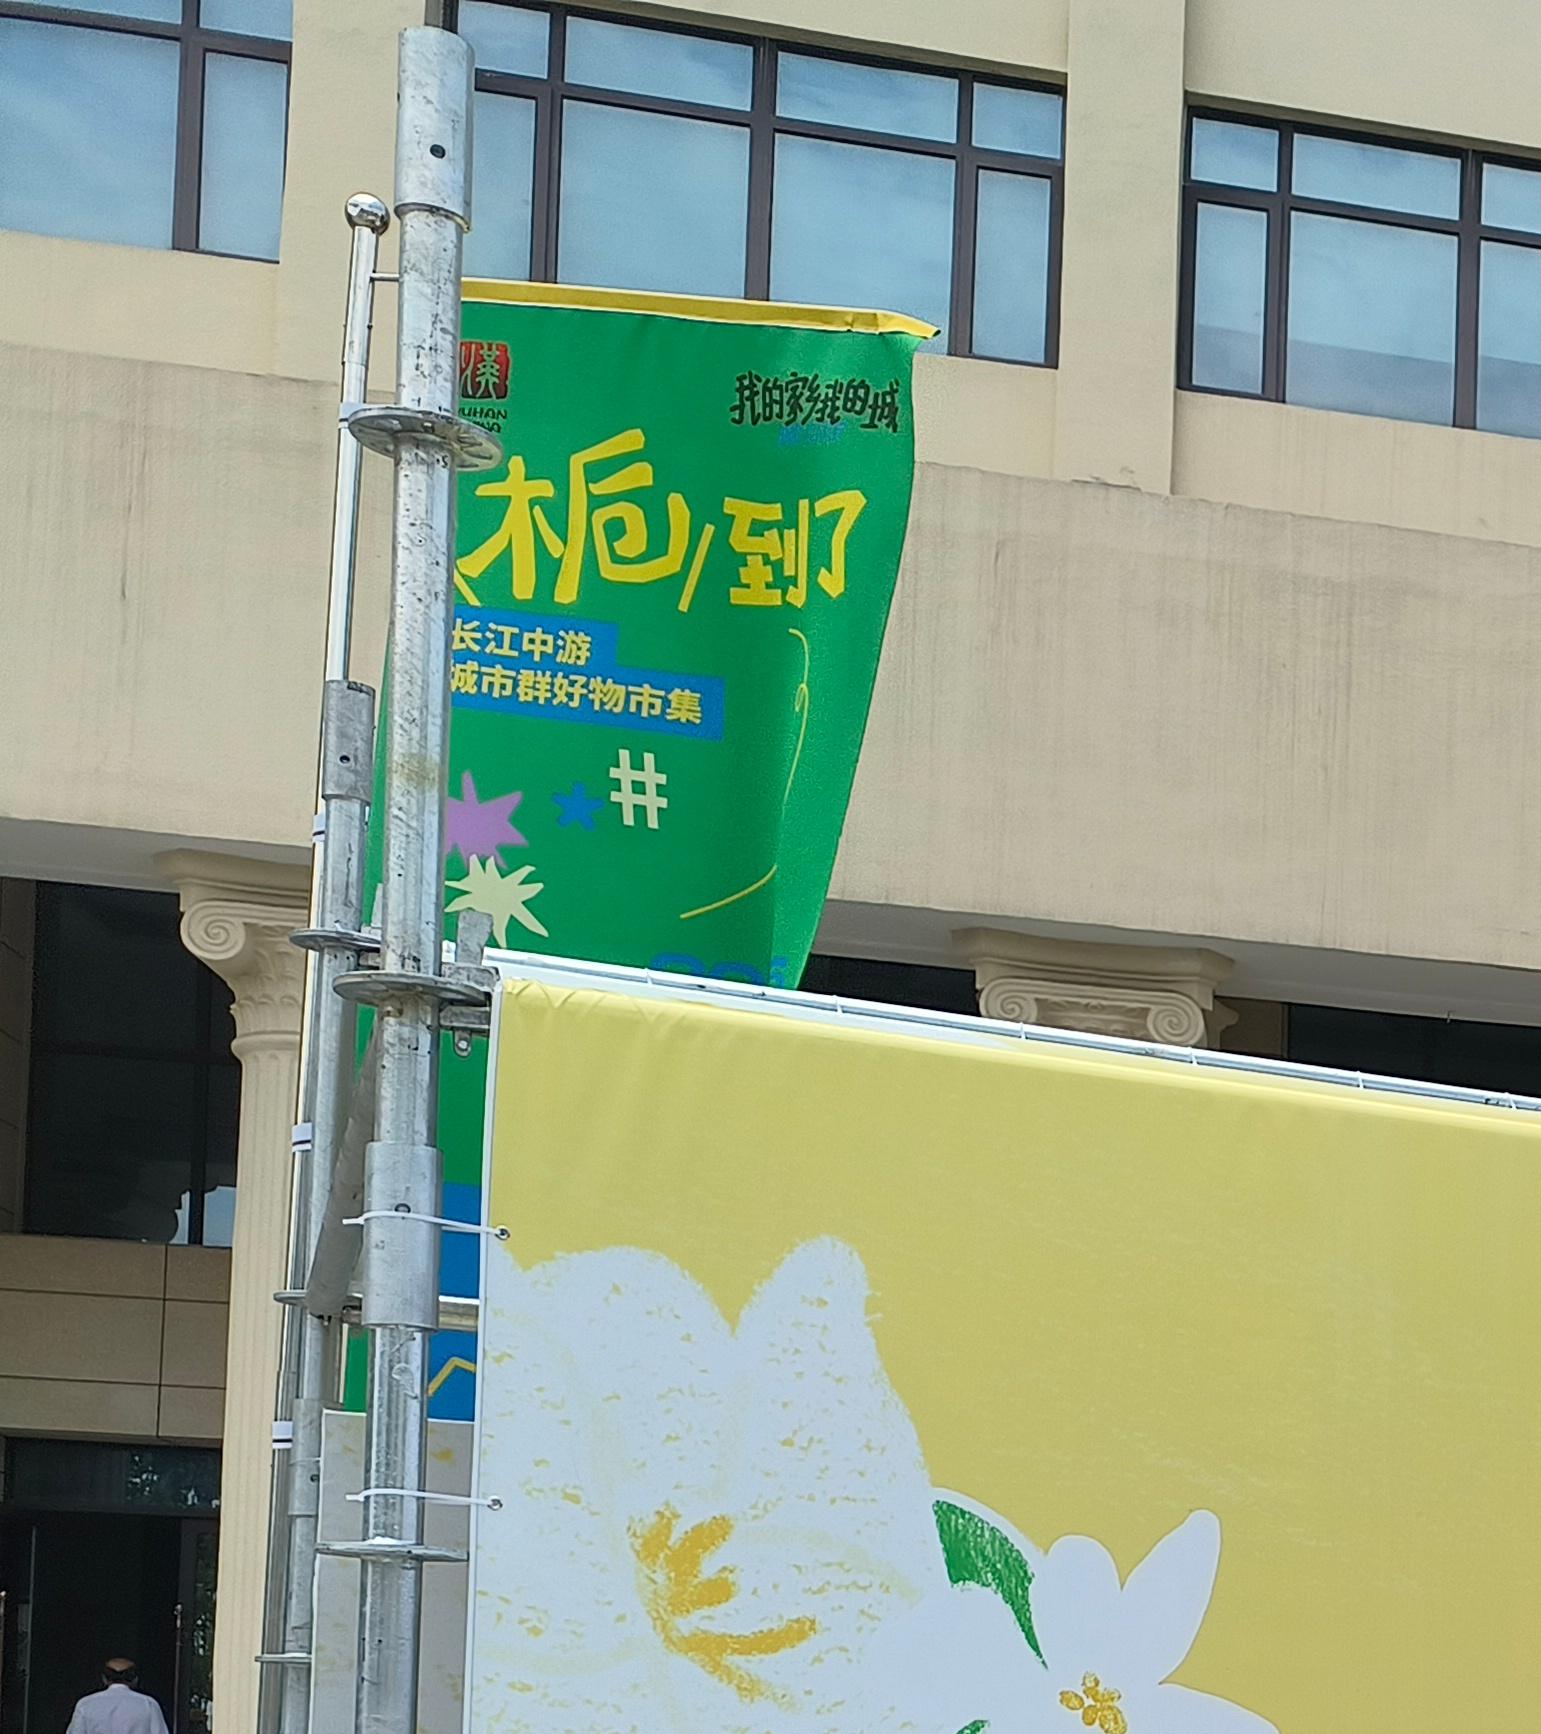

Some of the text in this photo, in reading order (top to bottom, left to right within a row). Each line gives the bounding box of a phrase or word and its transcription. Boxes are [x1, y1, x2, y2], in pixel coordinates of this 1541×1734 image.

[459, 407, 508, 420] UHAN
[451, 618, 592, 666] 长江中游
[450, 659, 702, 725] 城市群好物市集
